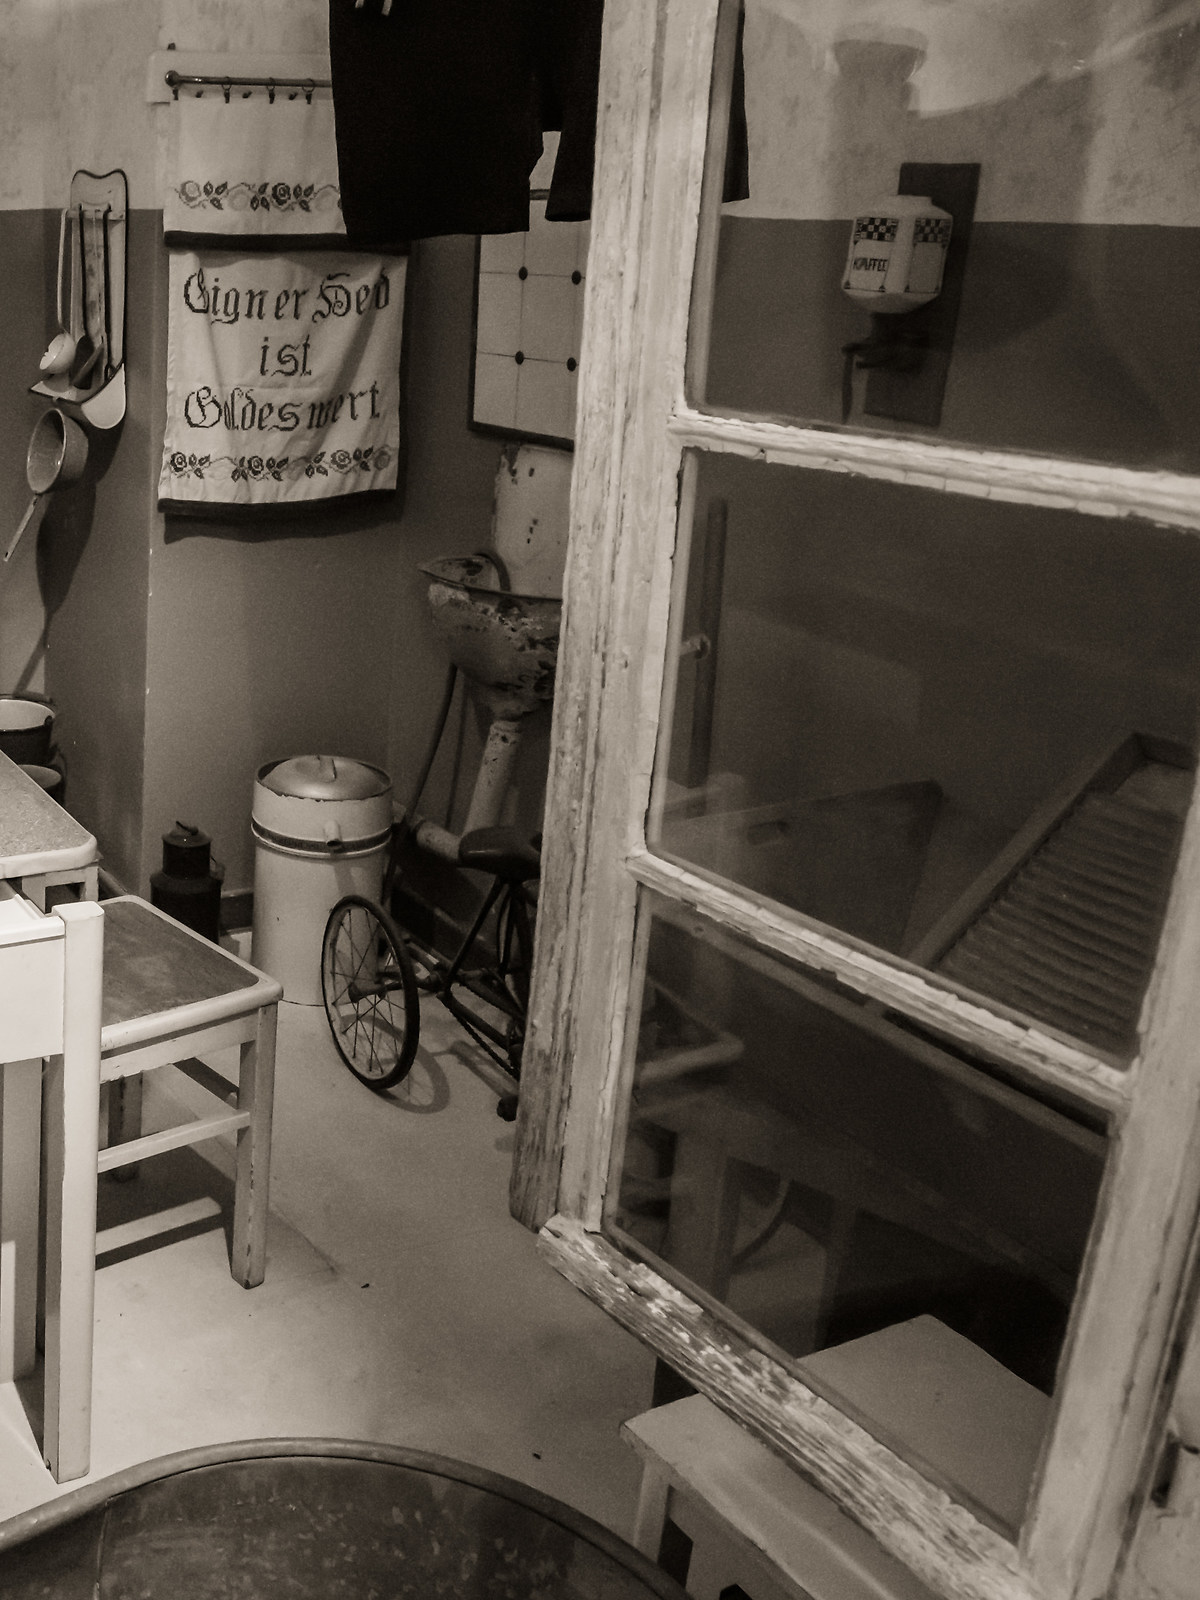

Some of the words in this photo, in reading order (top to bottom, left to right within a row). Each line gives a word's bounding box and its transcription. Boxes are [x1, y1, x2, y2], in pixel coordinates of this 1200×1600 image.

[852, 258, 888, 271] KAFFEE
[184, 268, 308, 324] Eigner
[312, 266, 390, 324] Hed
[260, 335, 312, 376] ist
